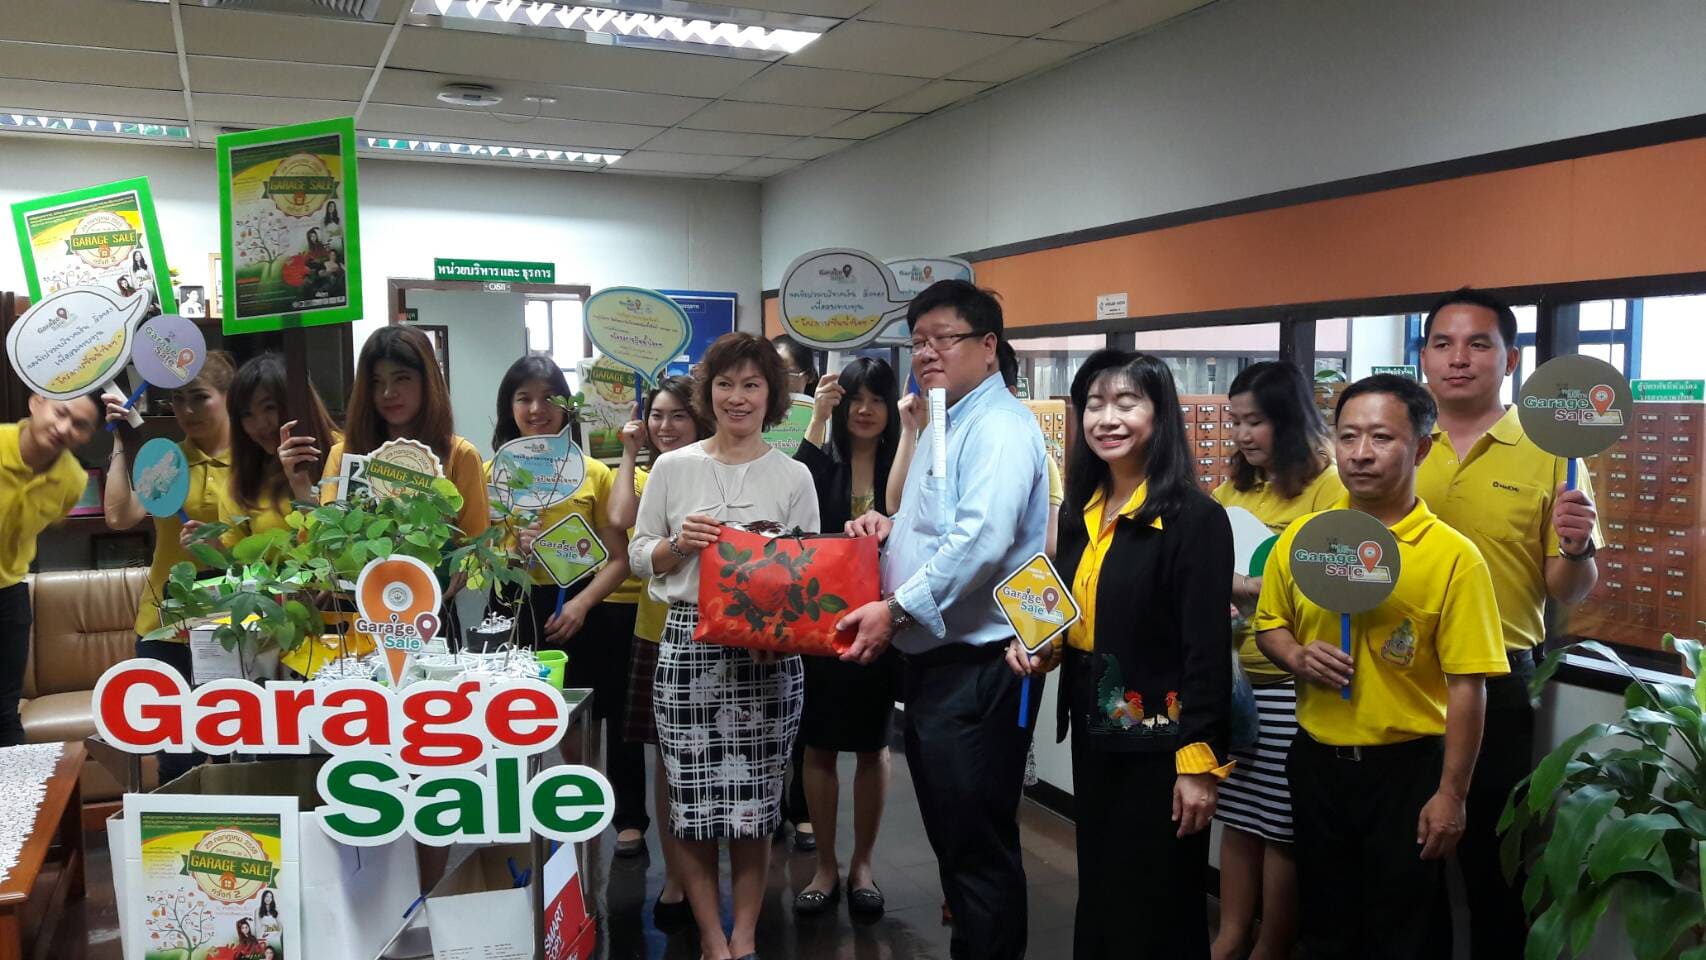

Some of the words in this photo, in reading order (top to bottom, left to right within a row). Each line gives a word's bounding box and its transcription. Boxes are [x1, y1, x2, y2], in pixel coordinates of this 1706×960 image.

[271, 180, 304, 191] GARAGE
[72, 236, 108, 247] GARAGE
[112, 233, 136, 243] SALE
[437, 261, 498, 276] หน่วยบริหาร
[500, 268, 520, 277] และ
[522, 269, 551, 281] ธุรการ
[145, 326, 177, 356] Garage
[154, 346, 175, 368] Sale
[1524, 396, 1589, 410] Garage
[1555, 409, 1594, 421] Sale
[370, 463, 408, 481] GARAGE
[540, 540, 577, 551] Garage
[556, 550, 577, 559] Sale
[1295, 549, 1357, 564] Garage
[1326, 564, 1363, 576] Sale
[1003, 586, 1041, 604] Garage
[1021, 601, 1044, 614] Sale
[356, 619, 415, 636] Garage
[385, 636, 420, 649] Sale
[100, 669, 559, 767] Garage
[324, 758, 605, 838] Sale
[205, 840, 213, 849] 29
[190, 855, 237, 872] GARAGE
[241, 863, 270, 876] SALE
